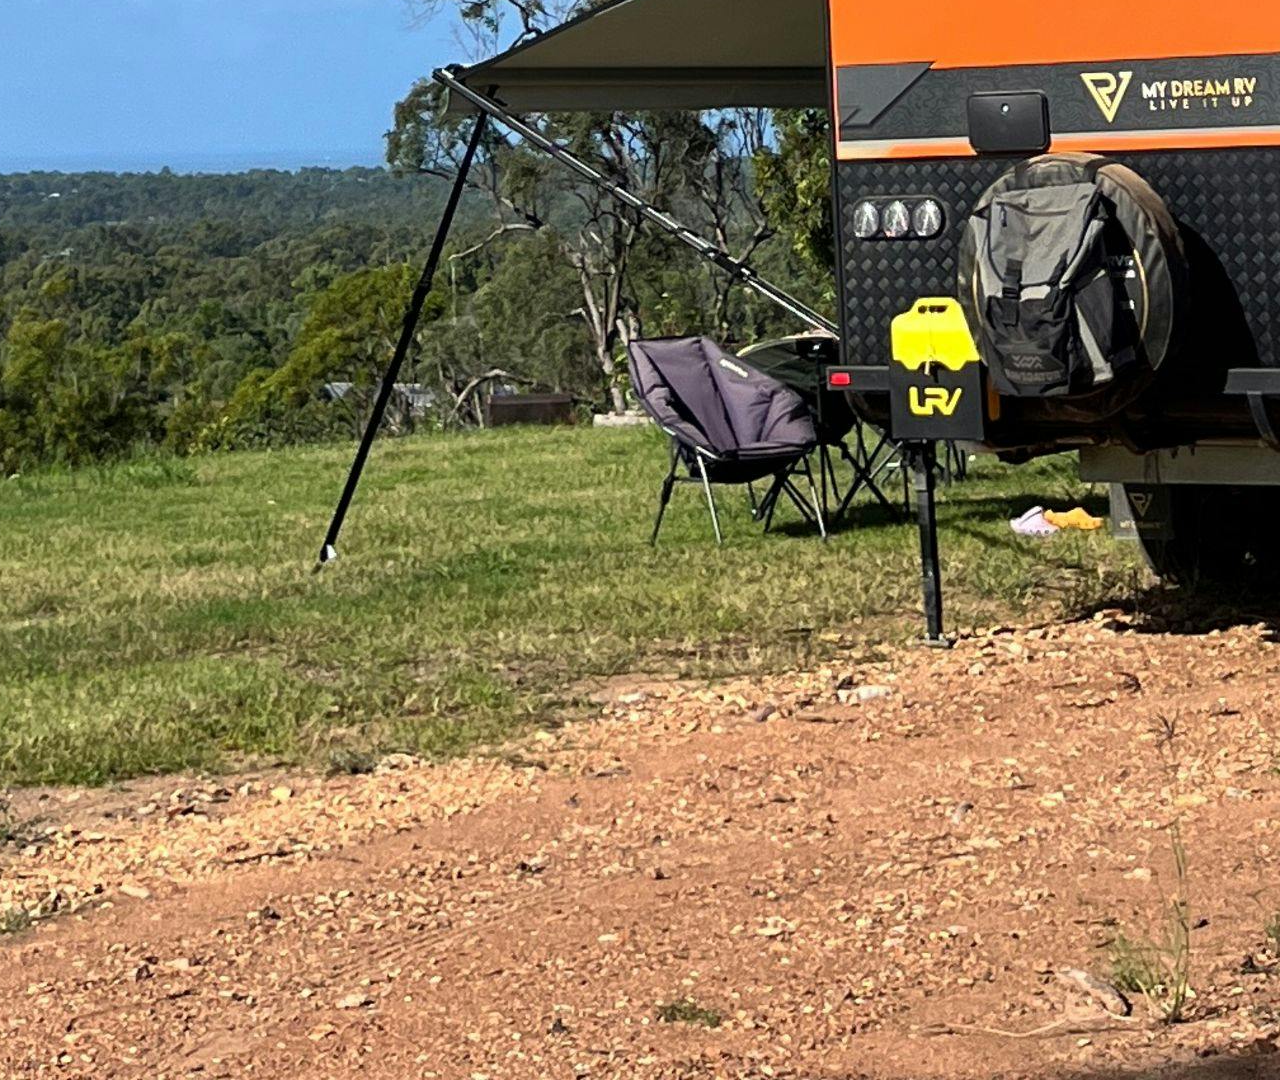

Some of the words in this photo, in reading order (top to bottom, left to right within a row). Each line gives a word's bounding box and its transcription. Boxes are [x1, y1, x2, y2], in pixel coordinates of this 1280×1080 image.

[1141, 81, 1167, 99] MY
[1170, 79, 1231, 98] DREAM
[1233, 77, 1257, 95] RV
[1149, 98, 1190, 111] LIVE
[1202, 97, 1218, 108] IT
[1231, 96, 1253, 108] UP
